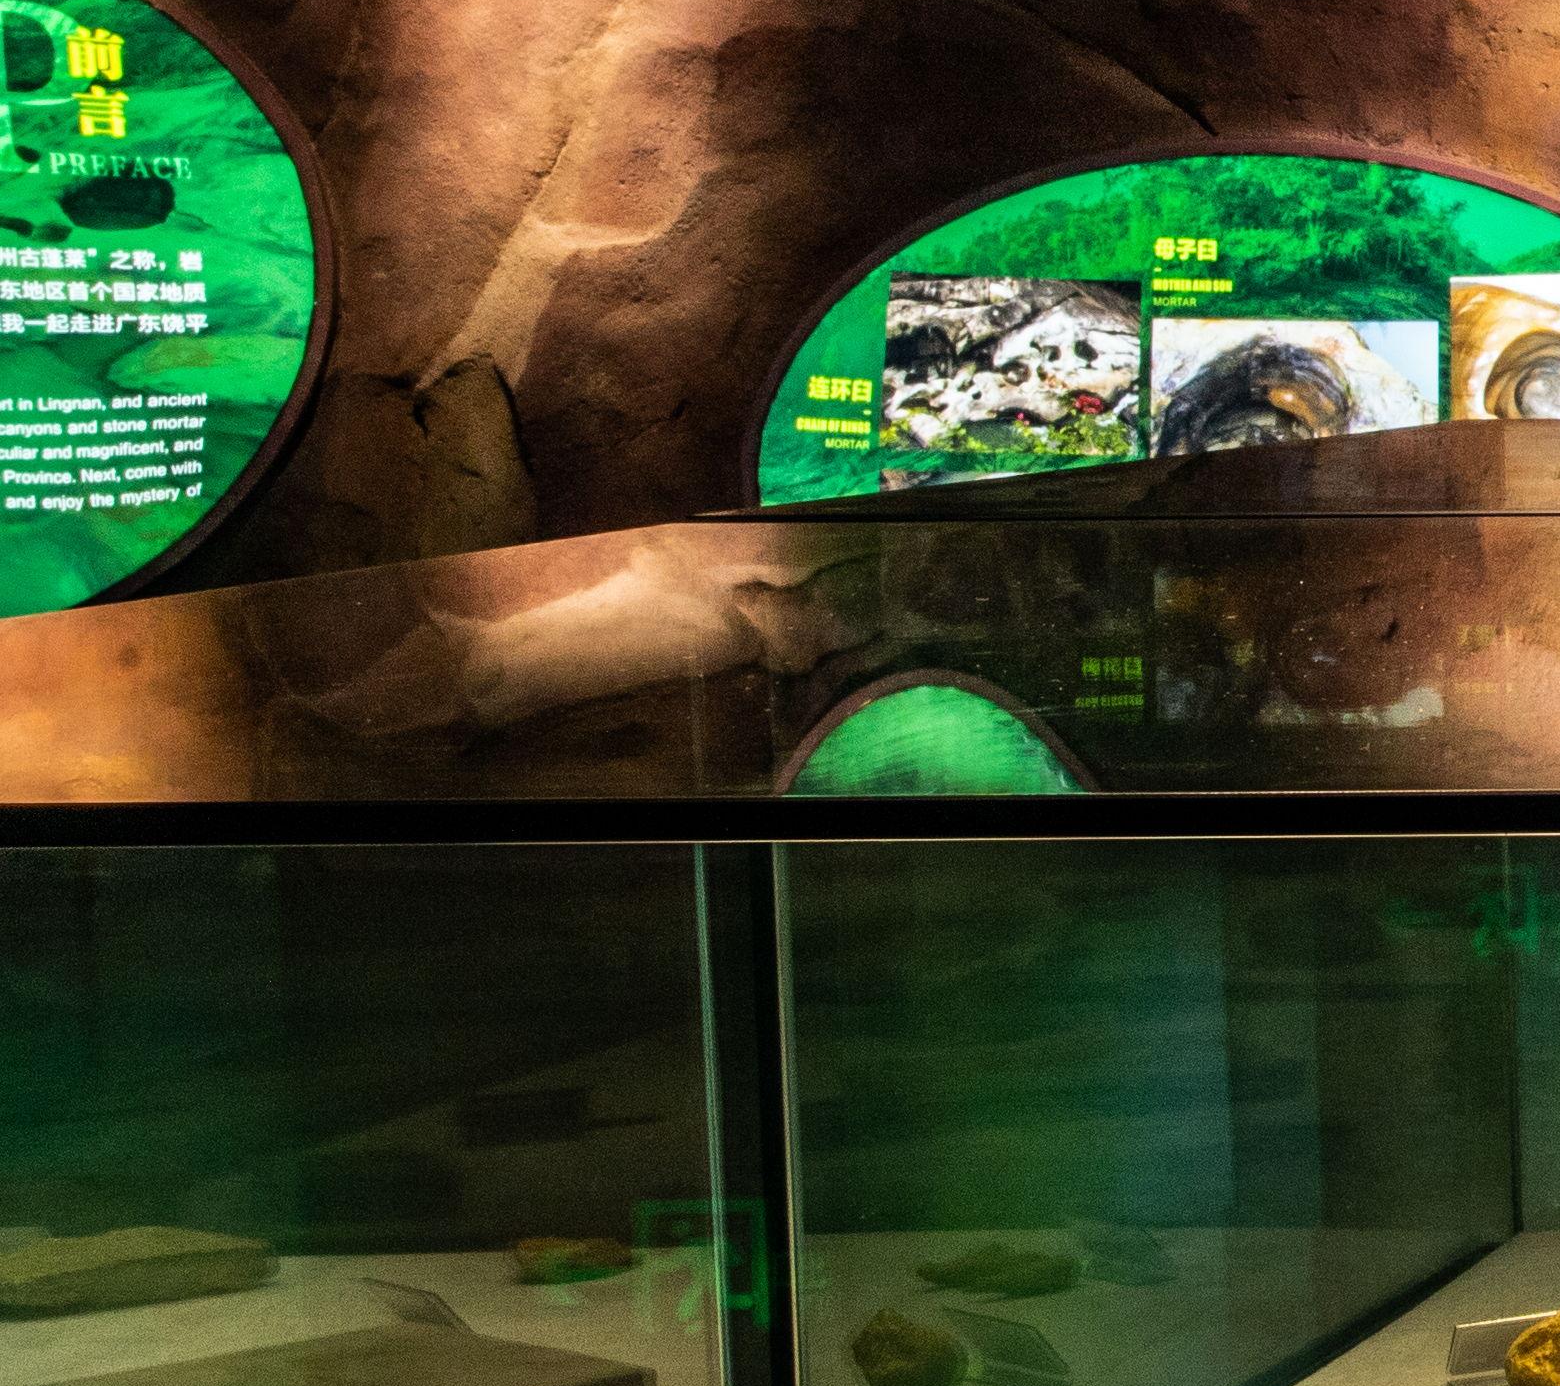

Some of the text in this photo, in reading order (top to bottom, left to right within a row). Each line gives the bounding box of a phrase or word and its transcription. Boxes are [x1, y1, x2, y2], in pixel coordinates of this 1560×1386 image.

[49, 152, 192, 180] PREFACE
[1153, 297, 1197, 307] MORTAR
[18, 393, 207, 413] in Lingnan, and ancient
[67, 421, 98, 435] and
[103, 419, 147, 433] stone
[152, 416, 206, 430] mortar
[42, 445, 72, 459] and
[76, 440, 169, 460] magnificent,
[173, 437, 204, 452] and
[825, 438, 870, 450] MORTAR
[3, 460, 202, 484] Province. Next, come with
[5, 482, 202, 512] and enjoy the mystery of
